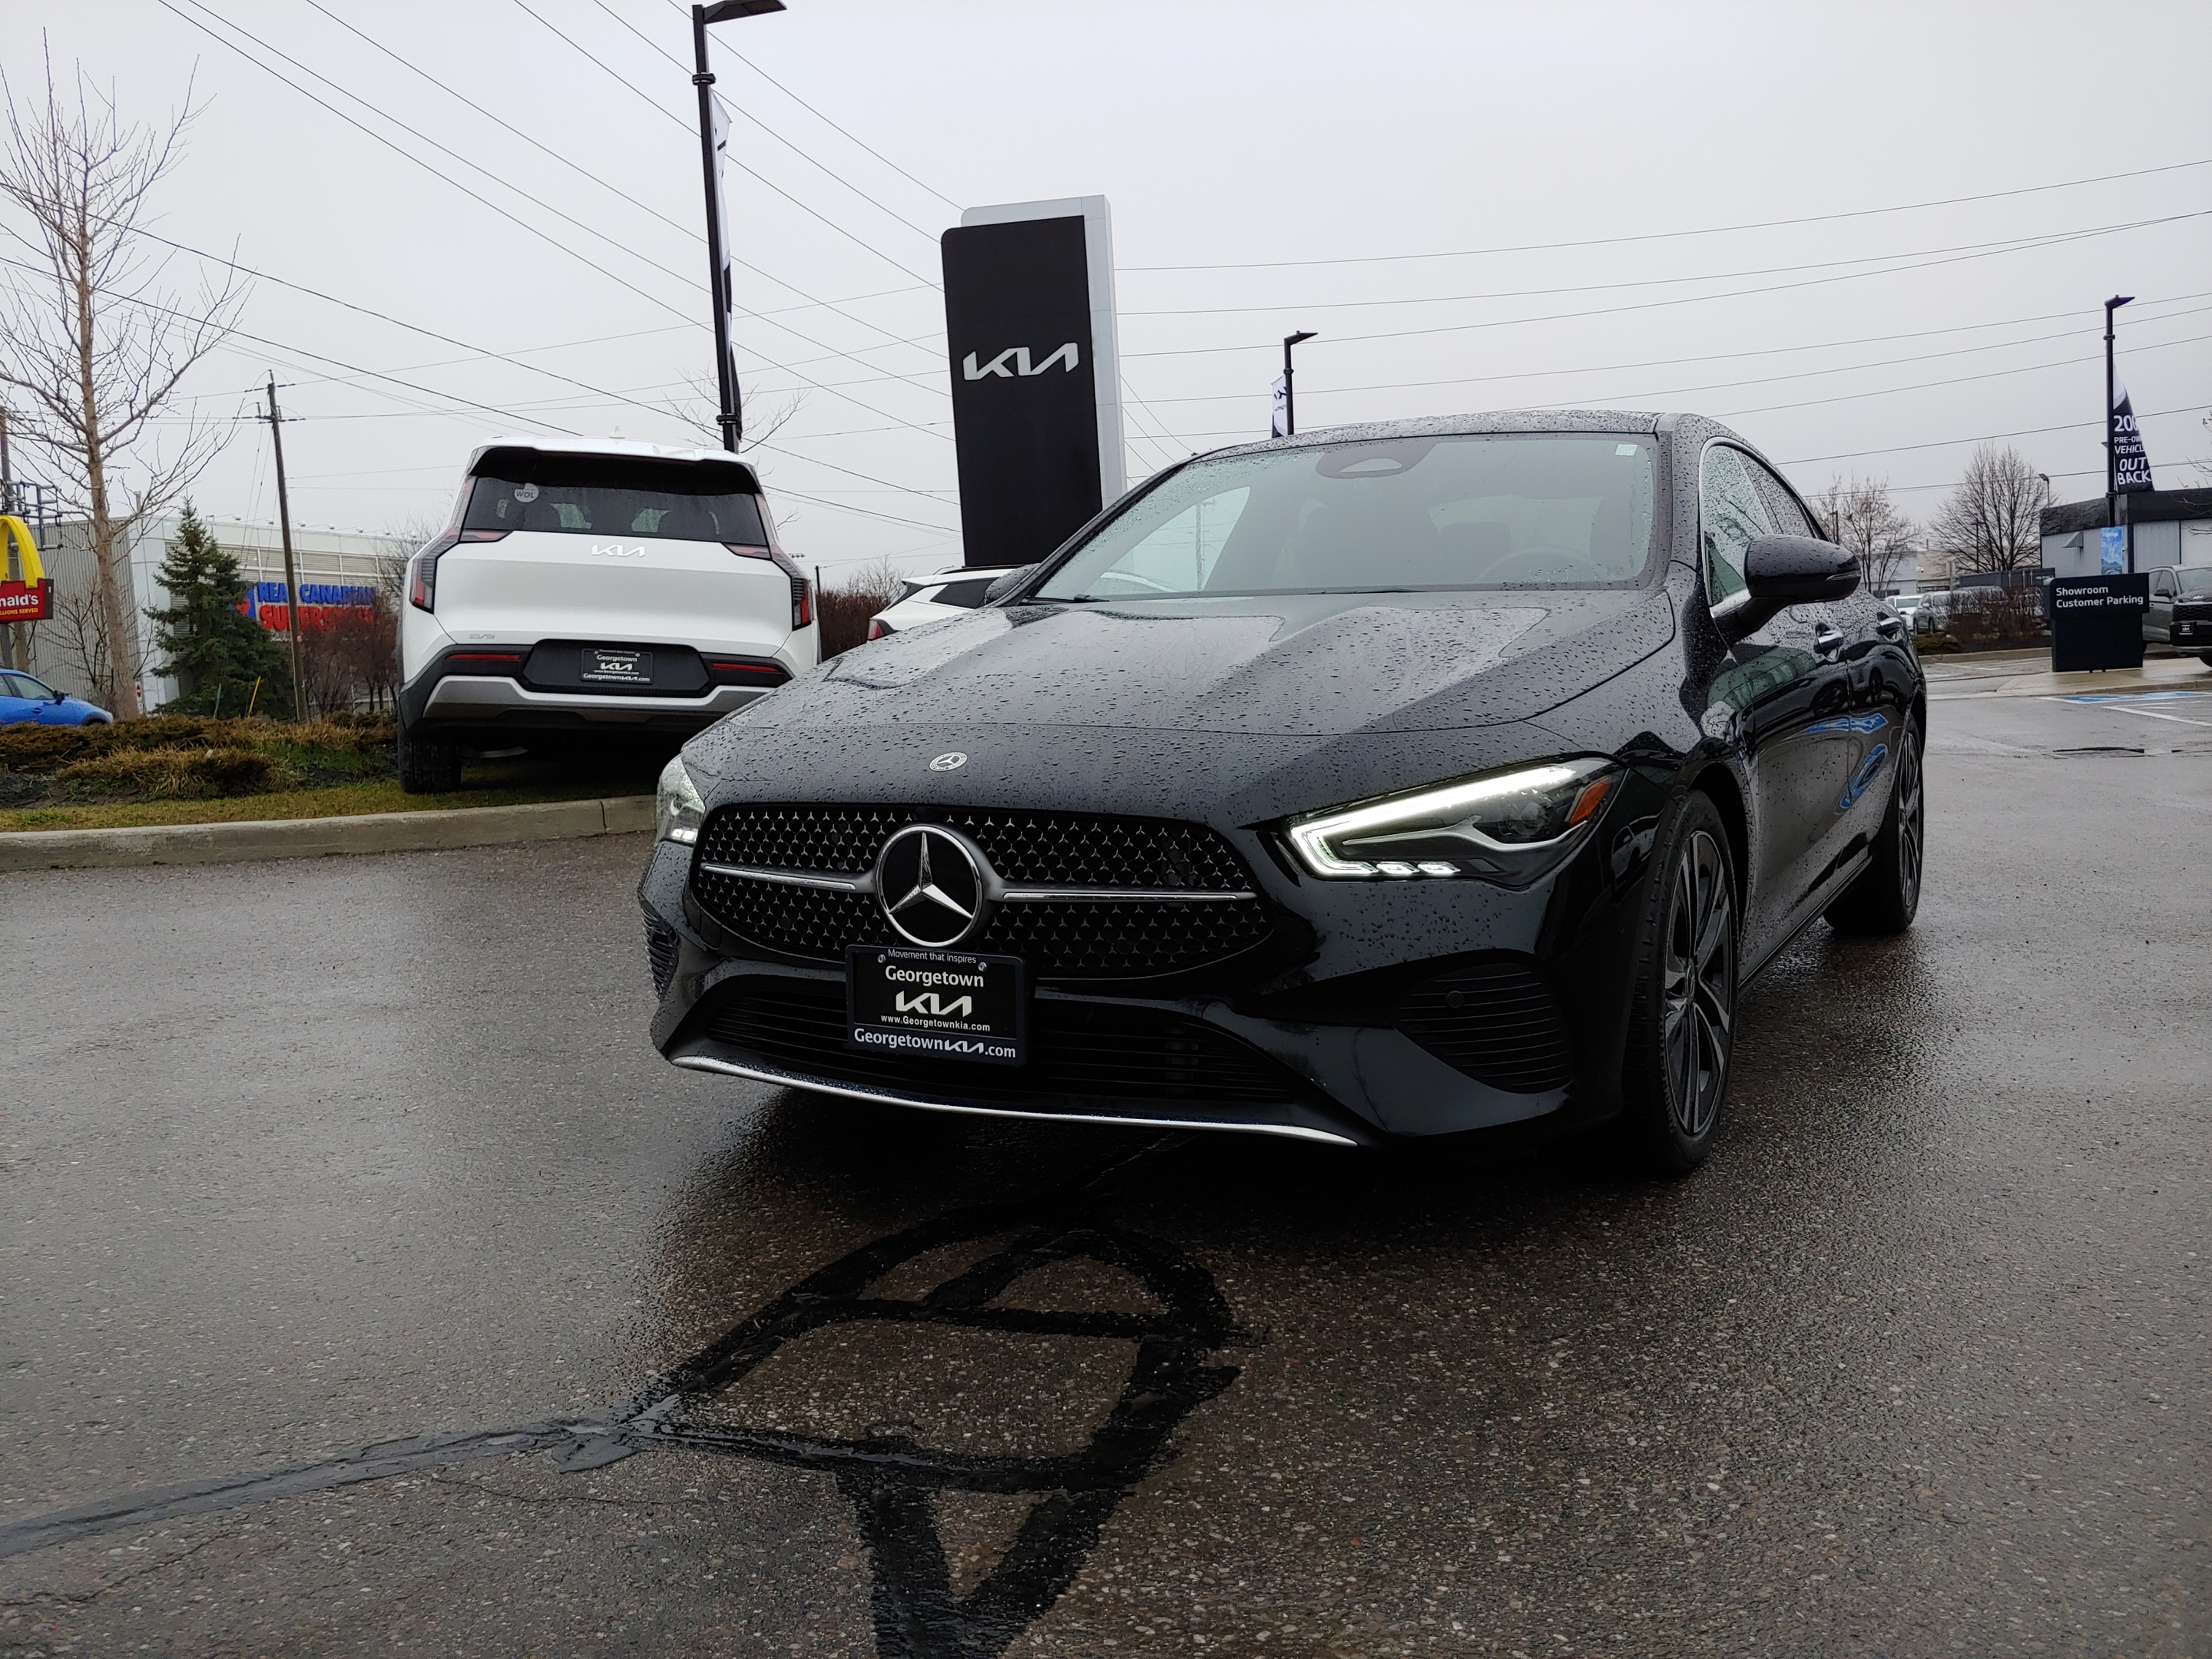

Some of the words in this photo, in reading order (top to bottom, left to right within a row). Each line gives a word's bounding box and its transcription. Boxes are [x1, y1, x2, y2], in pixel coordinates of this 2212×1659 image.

[962, 342, 1079, 381] KIA
[2119, 456, 2147, 472] OUT
[2117, 469, 2152, 485] BACK
[591, 544, 646, 558] KIA
[2055, 587, 2109, 596] Showroom
[2055, 598, 2104, 608] Customer
[2106, 595, 2144, 605] Parking
[597, 654, 638, 663] Georgetown
[600, 661, 633, 671] KIA
[888, 949, 928, 960] Movement
[929, 951, 945, 962] that
[946, 953, 977, 964] inspires
[885, 965, 984, 987] Georgetown
[896, 990, 972, 1018] KIA
[880, 1015, 991, 1031] www.Georgetownkia.com
